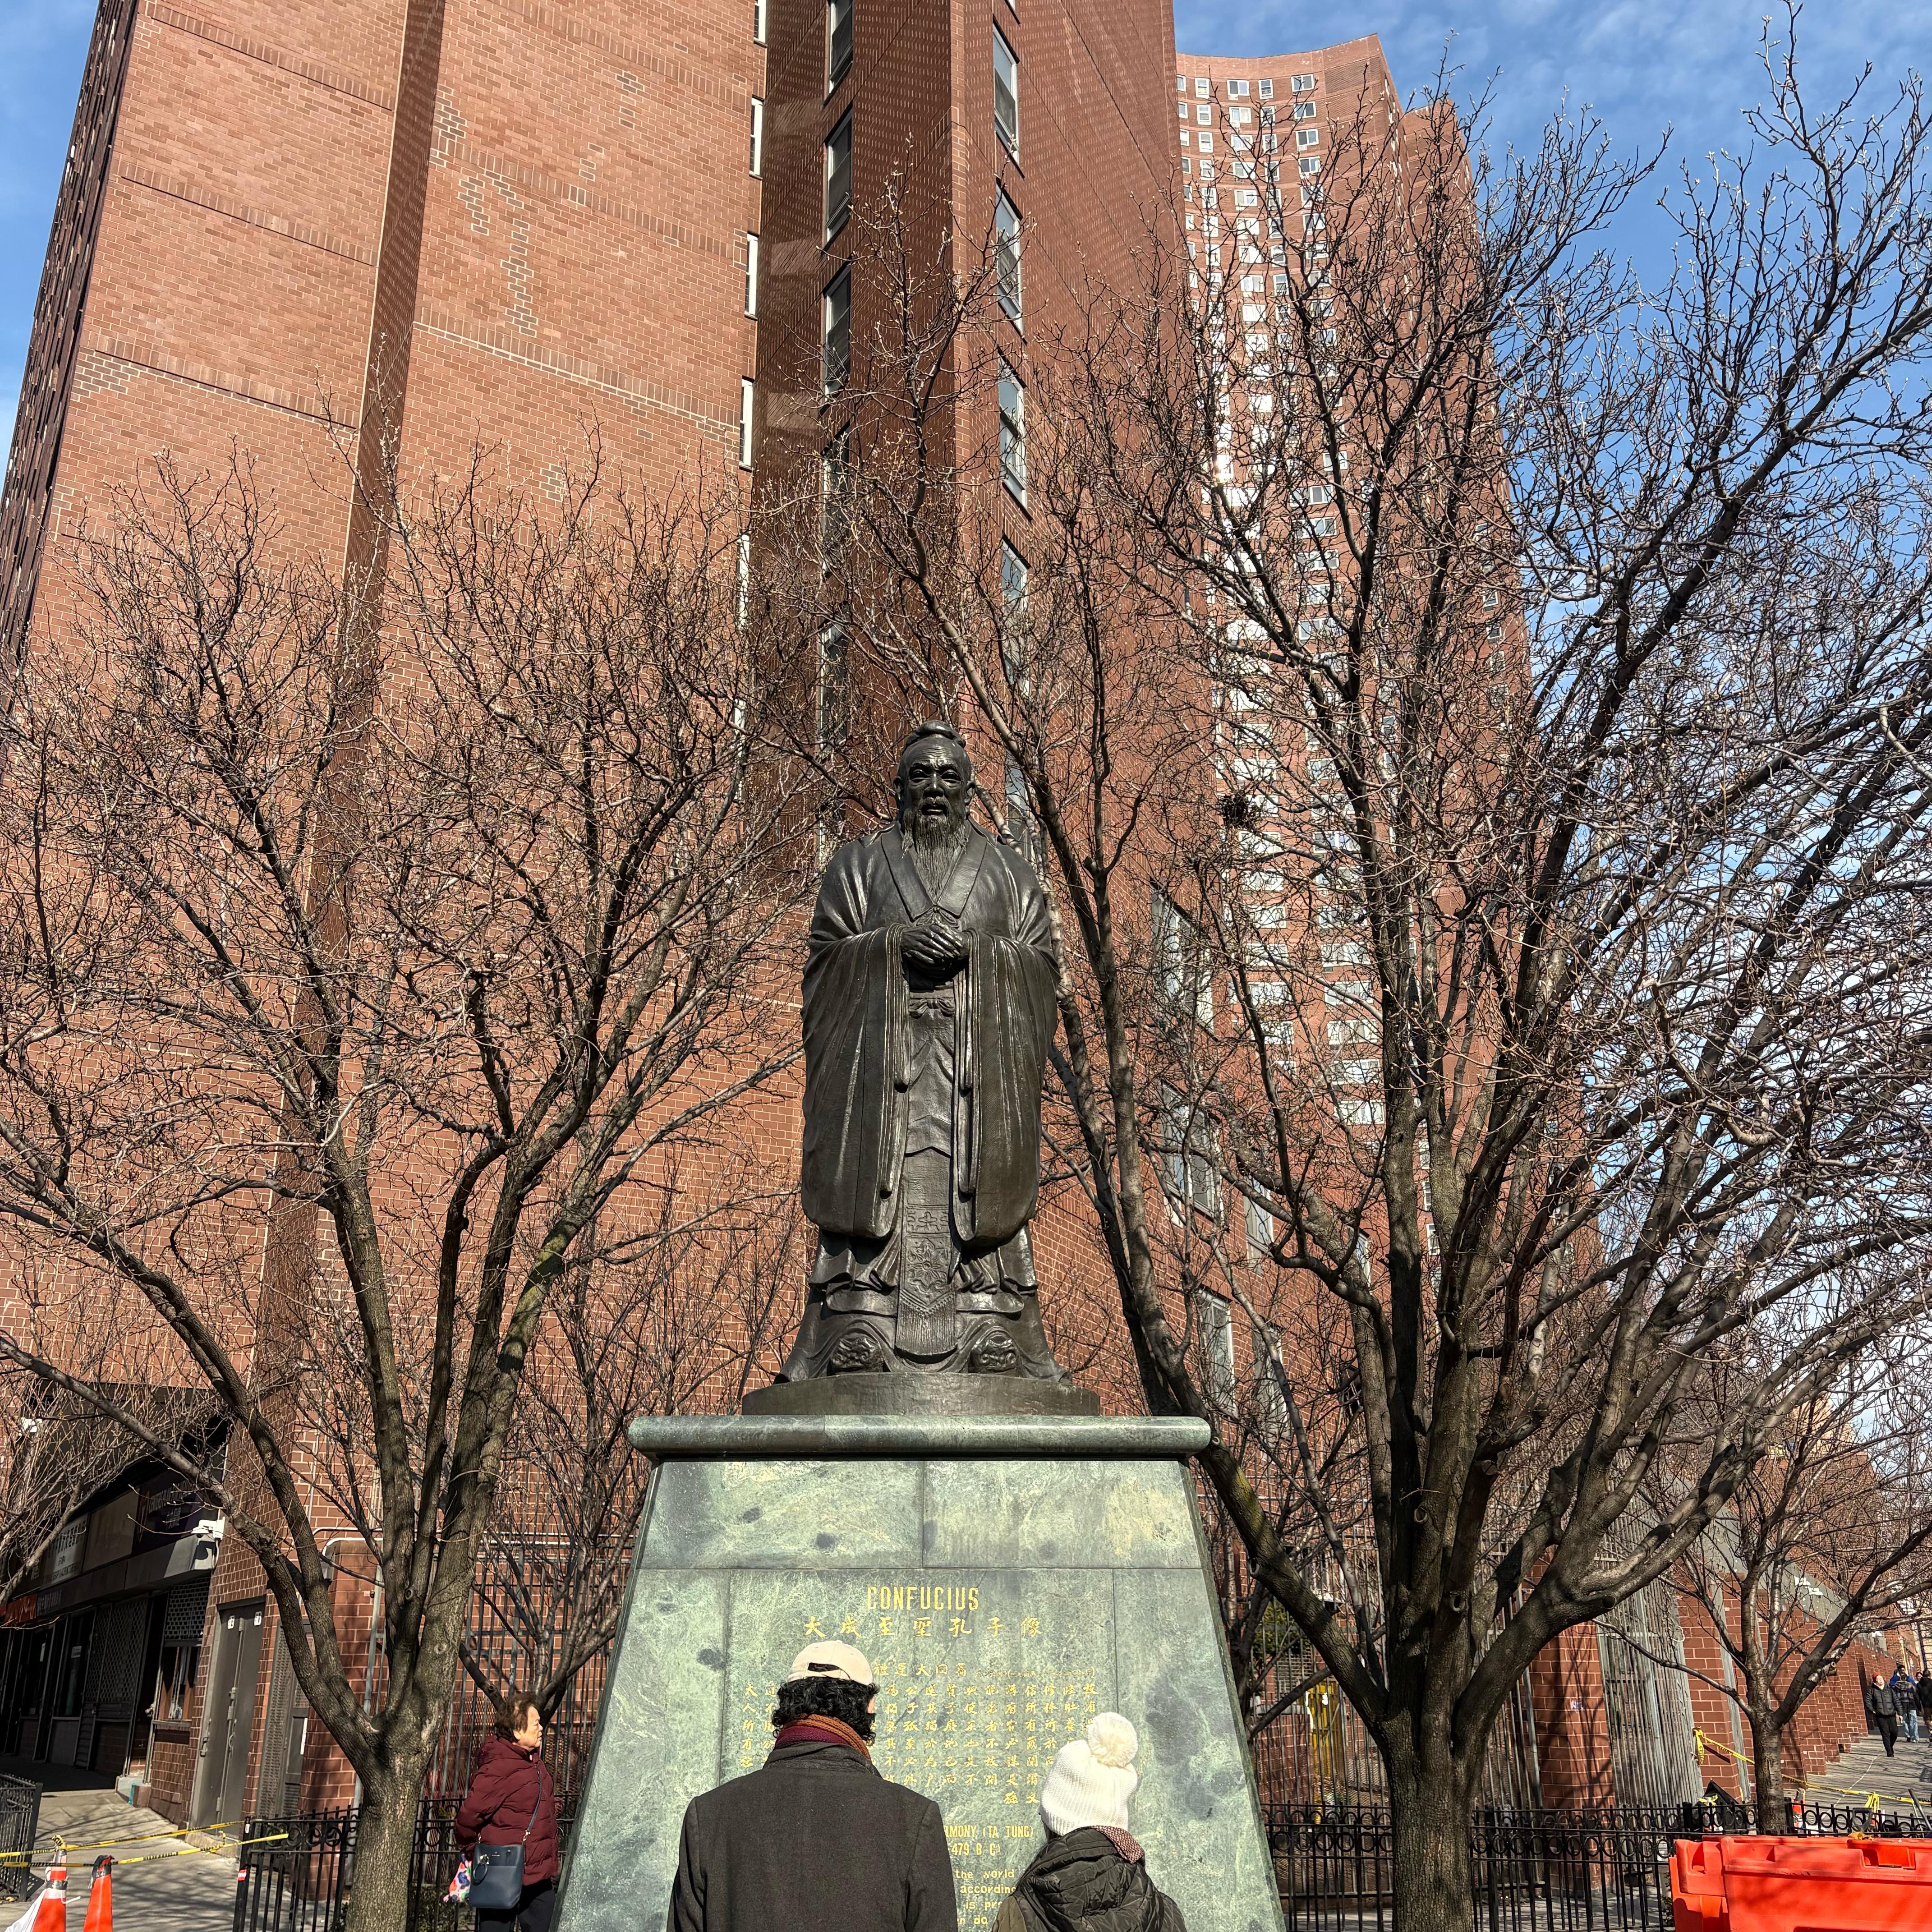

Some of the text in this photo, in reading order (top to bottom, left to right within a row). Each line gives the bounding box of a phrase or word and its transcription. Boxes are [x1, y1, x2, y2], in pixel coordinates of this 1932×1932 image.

[866, 1585, 979, 1611] CONFUCIUS
[943, 1825, 1034, 1838] RMONY (TA TUNG)
[951, 1842, 970, 1856] 479
[955, 1869, 973, 1879] the
[965, 1900, 975, 1909] is
